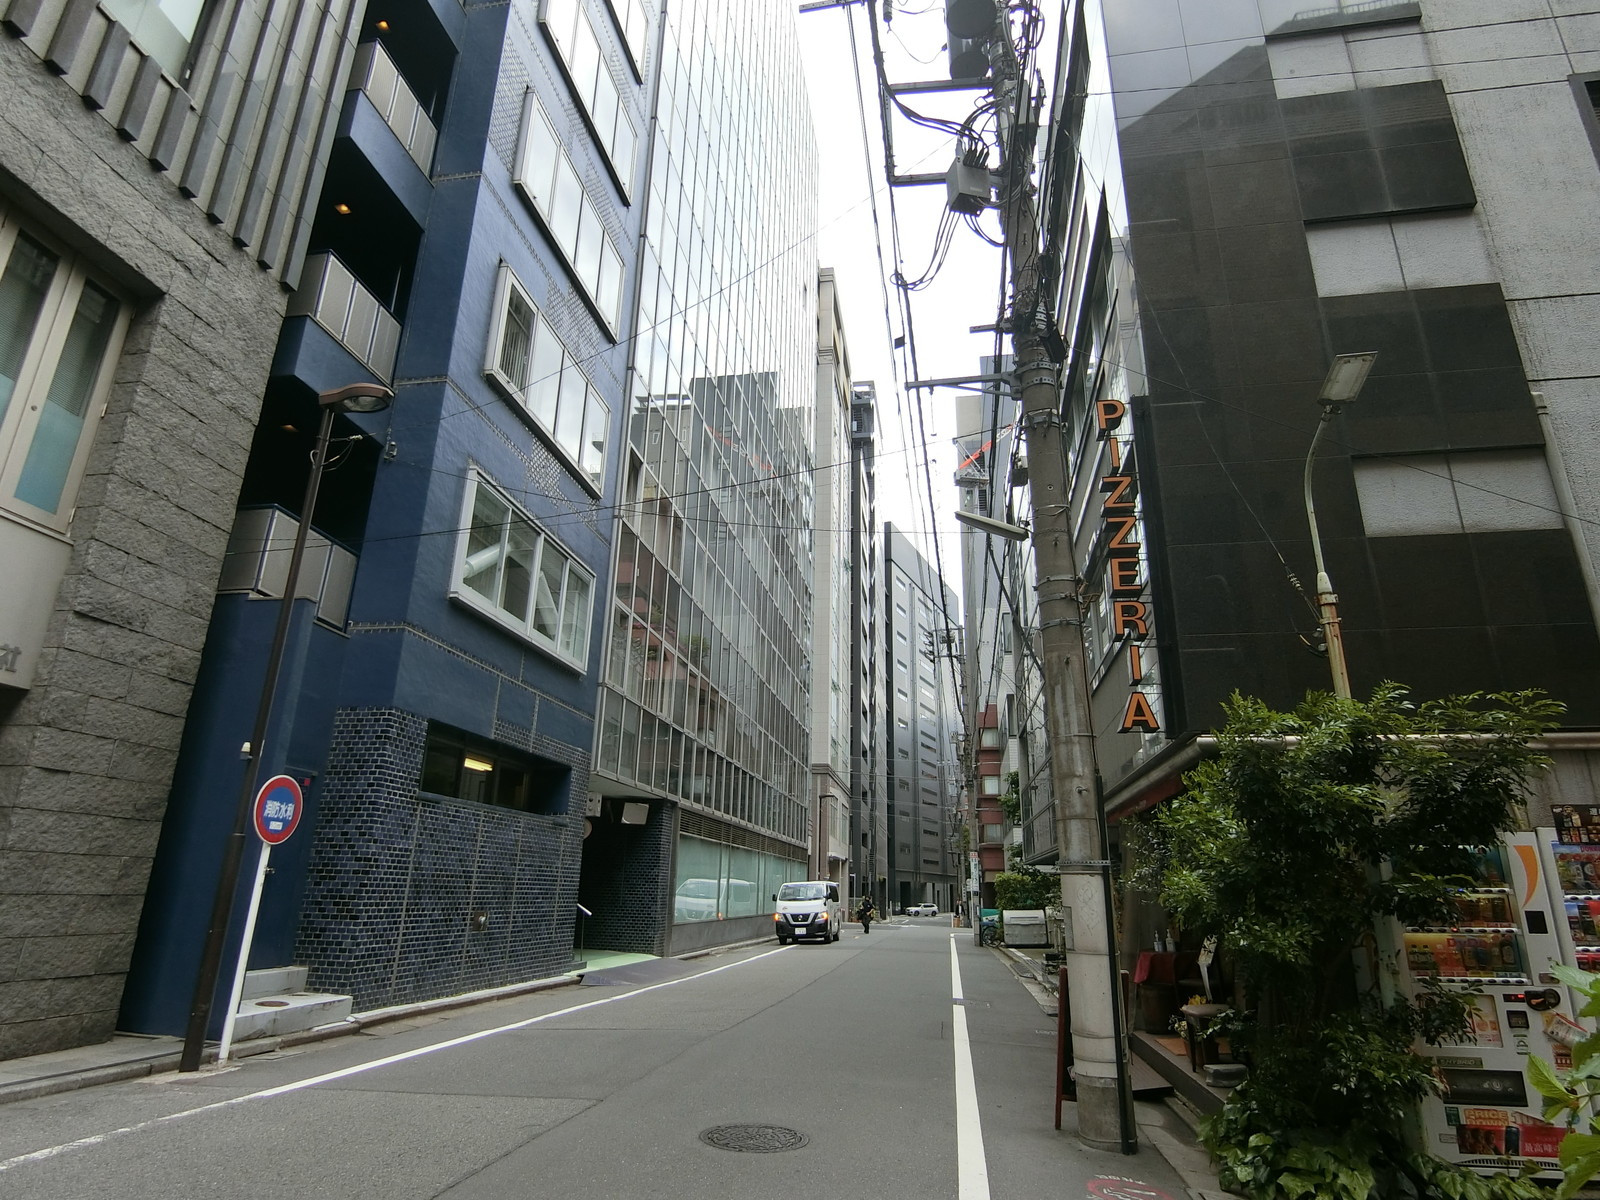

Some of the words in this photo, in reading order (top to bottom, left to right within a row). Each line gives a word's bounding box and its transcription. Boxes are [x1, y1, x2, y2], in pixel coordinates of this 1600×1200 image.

[1095, 399, 1161, 733] PIZZERIA
[263, 799, 295, 820] 消防水利
[1465, 1109, 1507, 1119] PRICE
